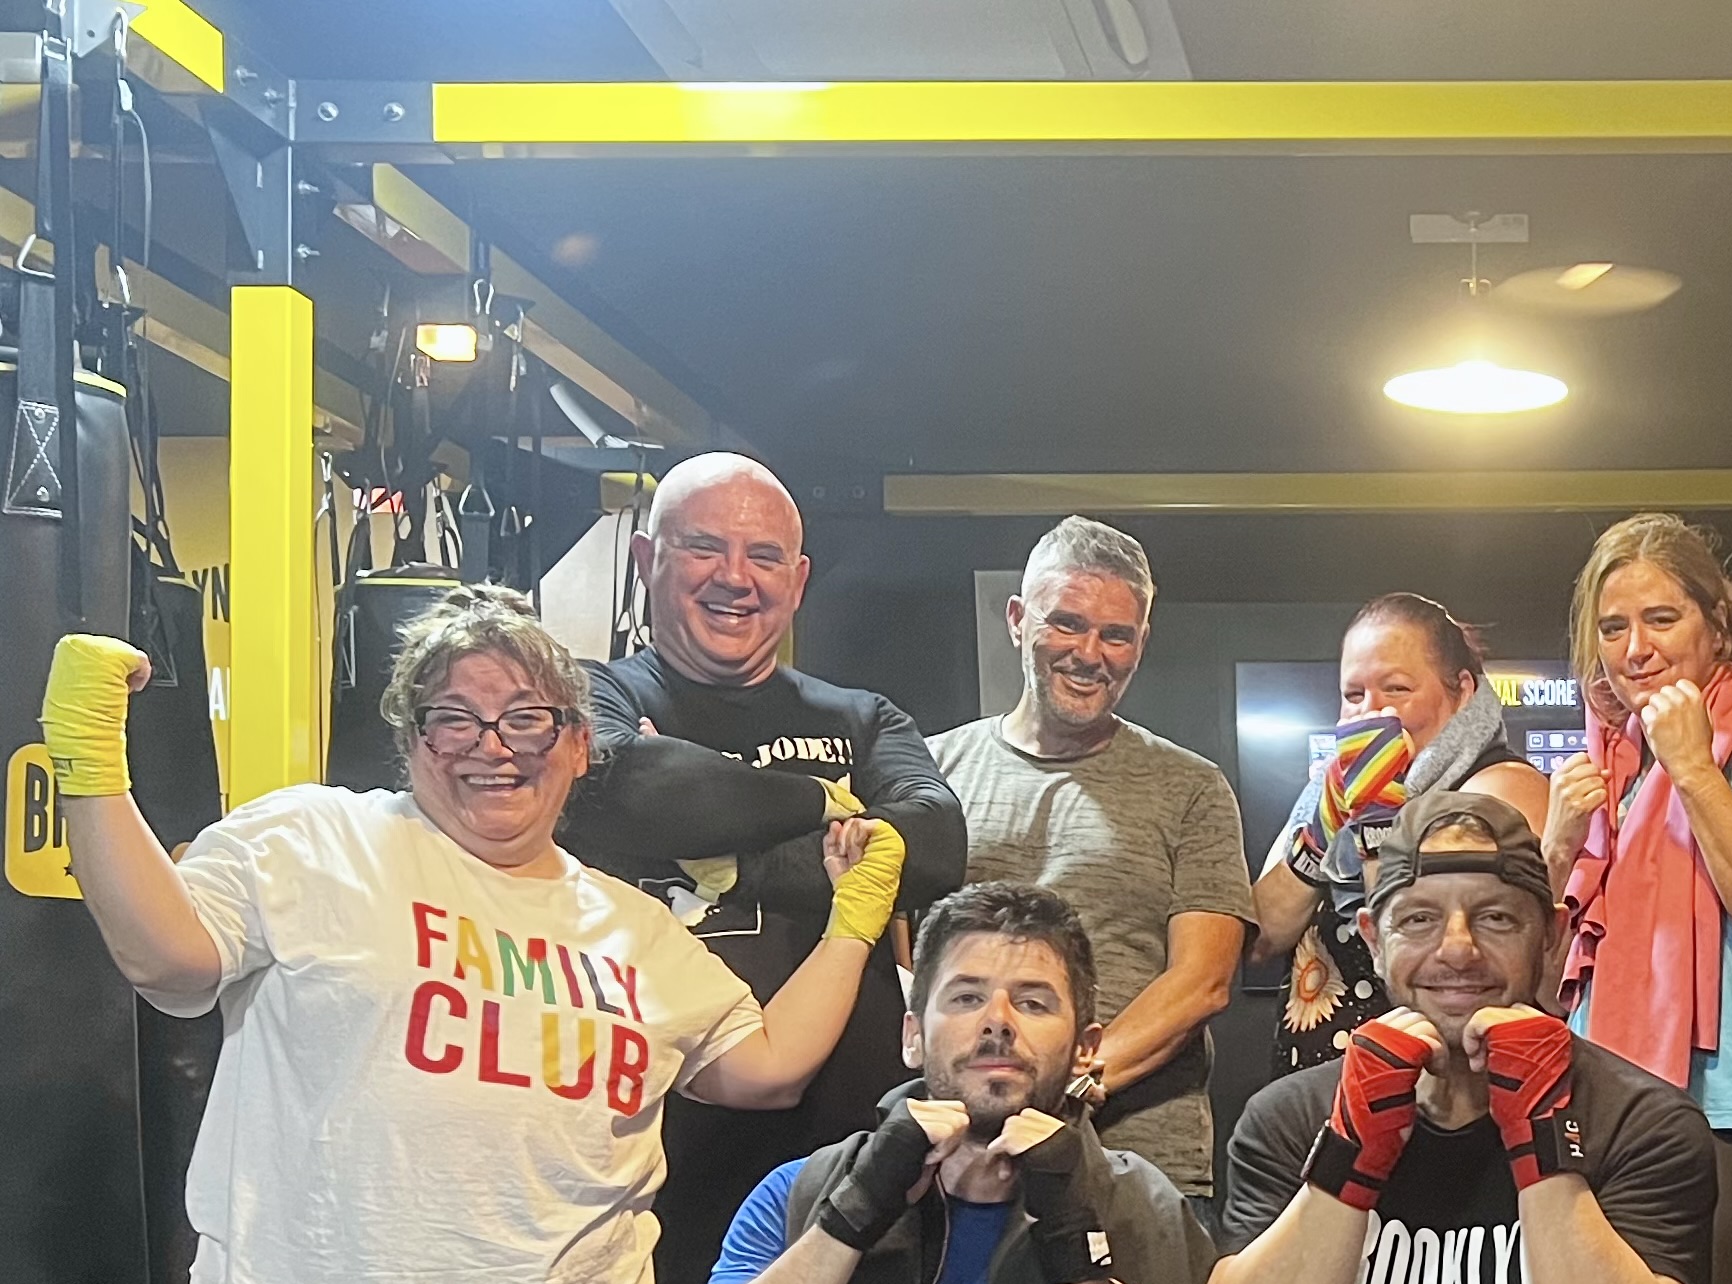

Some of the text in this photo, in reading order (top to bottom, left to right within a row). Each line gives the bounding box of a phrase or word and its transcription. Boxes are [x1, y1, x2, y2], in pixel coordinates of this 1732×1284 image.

[1522, 679, 1577, 706] SCORE
[412, 901, 645, 1024] FAMILY
[405, 980, 649, 1117] CLUB
